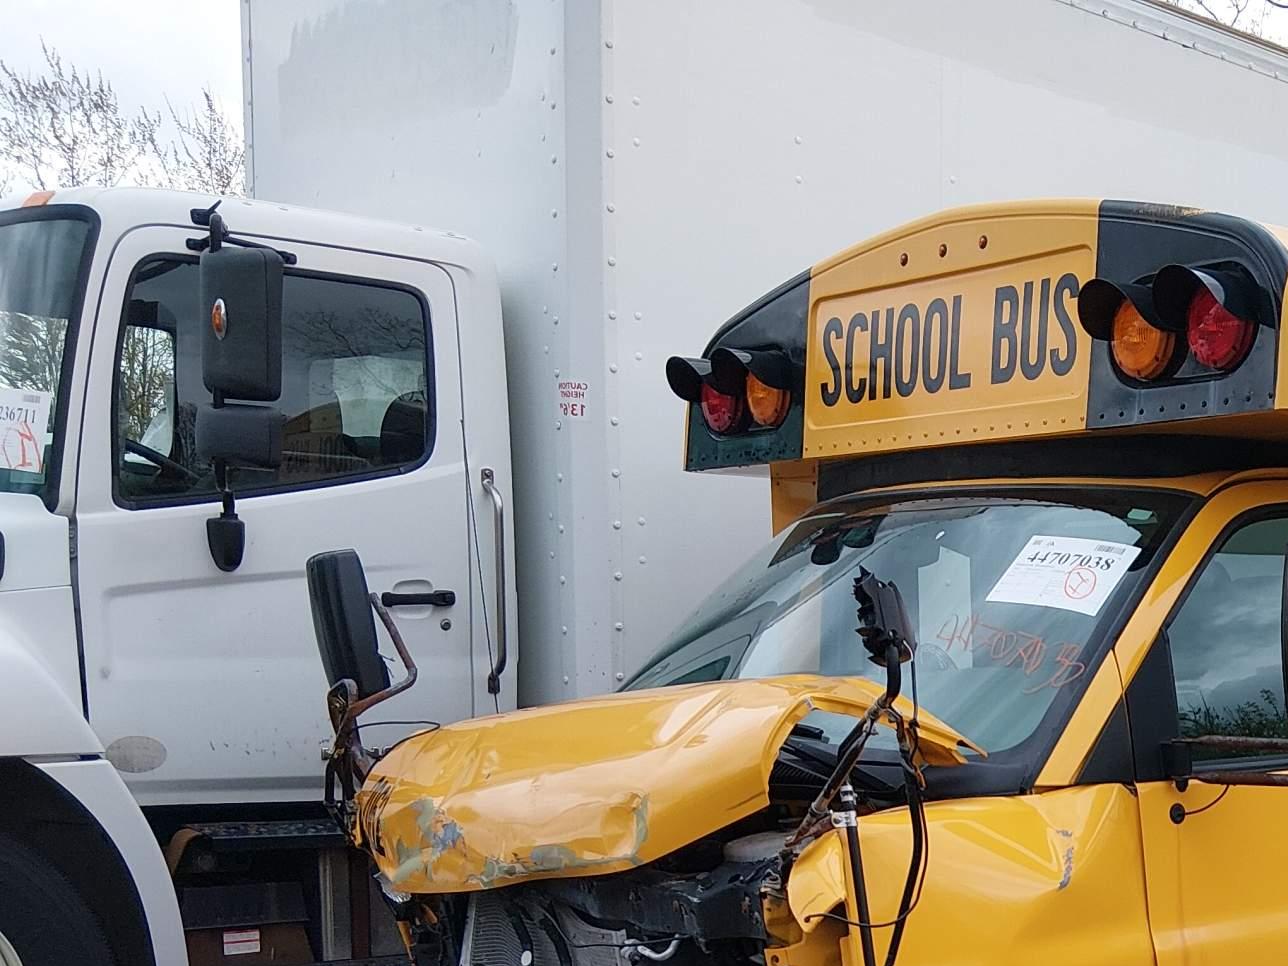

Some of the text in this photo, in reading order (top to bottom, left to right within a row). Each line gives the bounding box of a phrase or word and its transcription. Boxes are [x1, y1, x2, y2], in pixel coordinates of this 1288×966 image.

[820, 272, 1080, 407] SCHOOL BUS
[1026, 551, 1116, 572] 44707038
